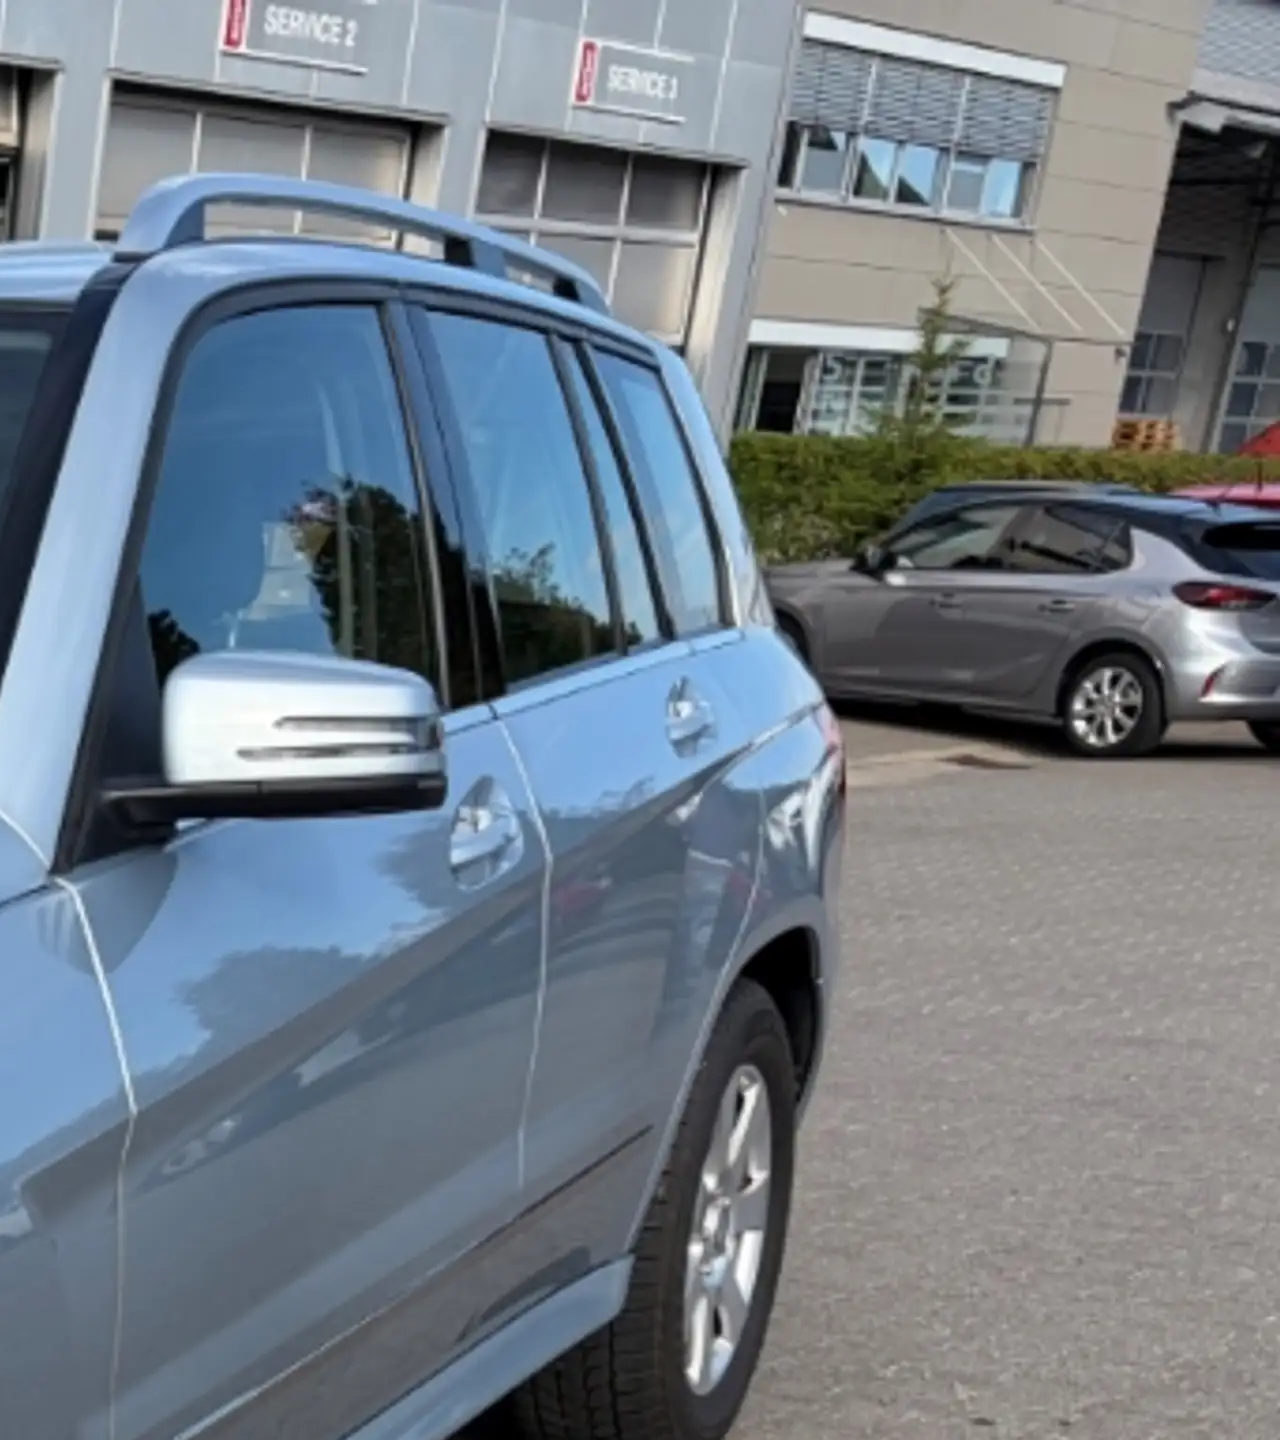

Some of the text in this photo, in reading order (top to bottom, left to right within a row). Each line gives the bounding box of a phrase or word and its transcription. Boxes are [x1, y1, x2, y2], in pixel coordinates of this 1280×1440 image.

[263, 4, 343, 46] SERVICE
[344, 18, 359, 47] 2
[608, 63, 669, 99] SERVICE
